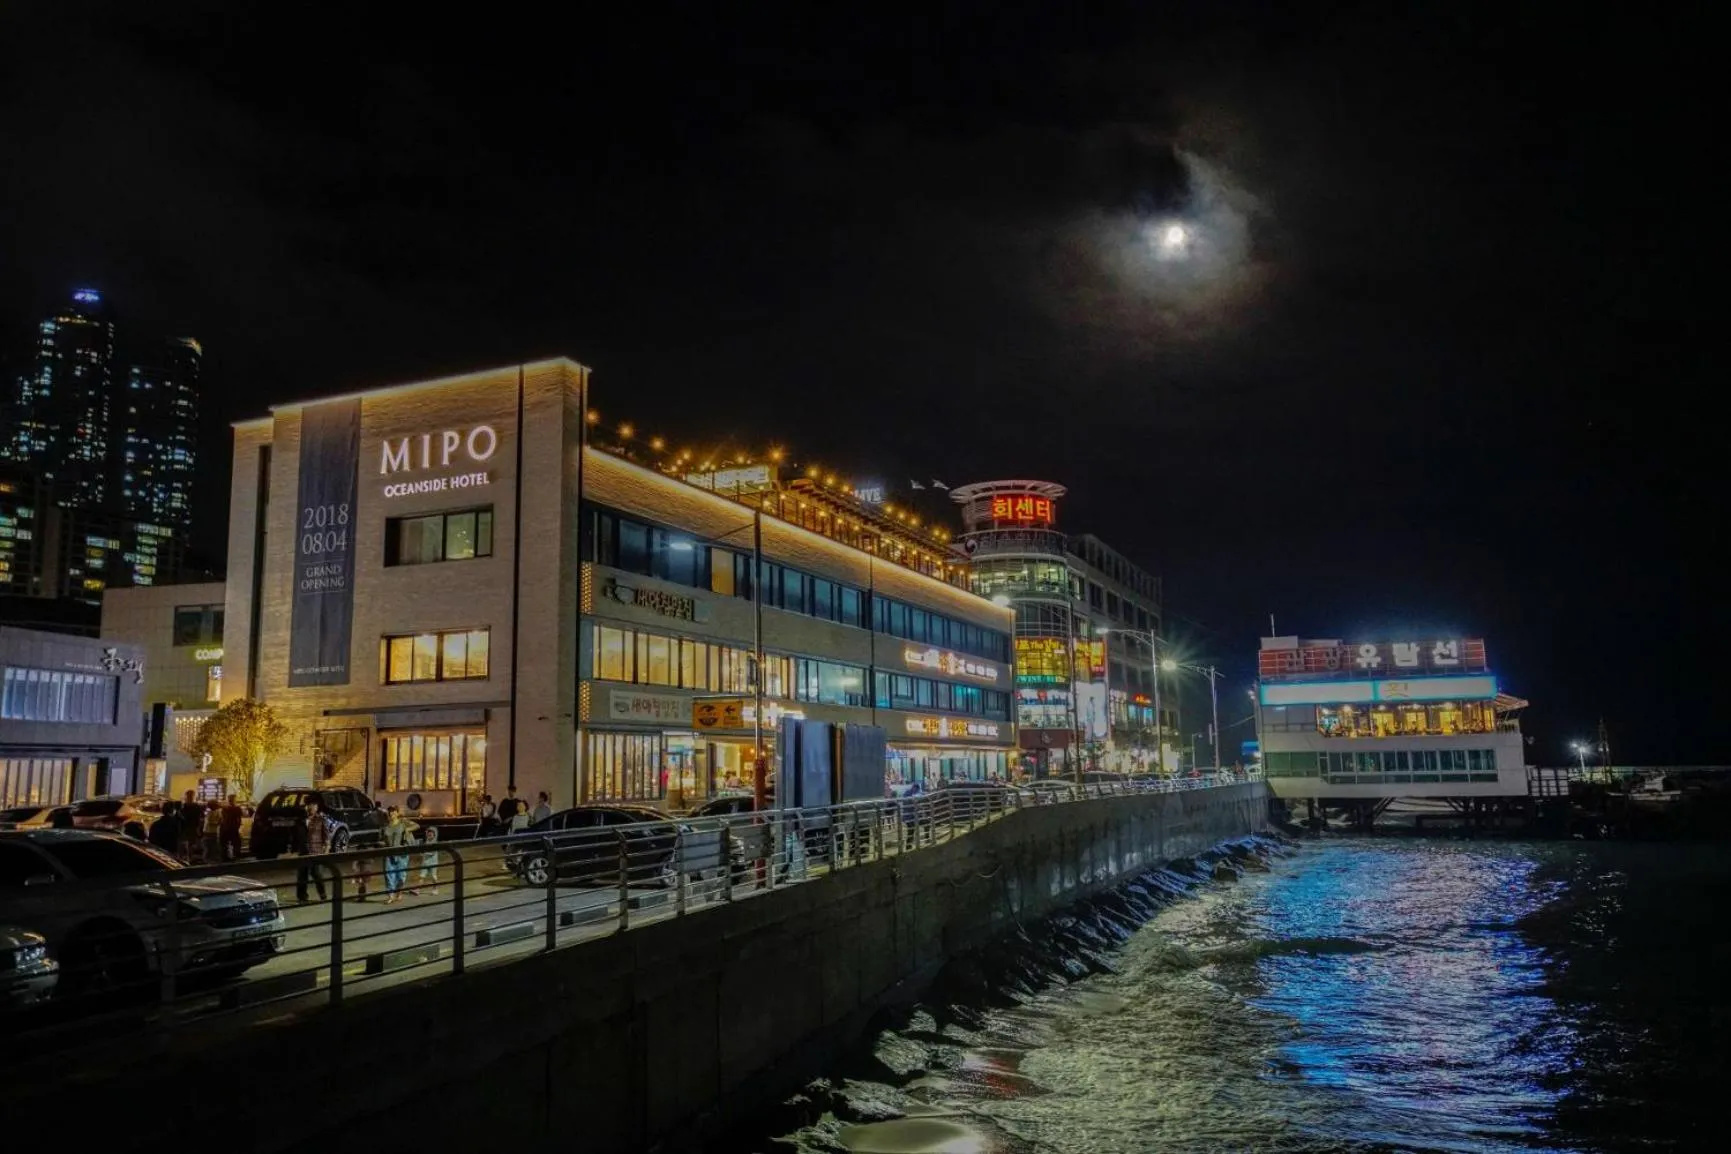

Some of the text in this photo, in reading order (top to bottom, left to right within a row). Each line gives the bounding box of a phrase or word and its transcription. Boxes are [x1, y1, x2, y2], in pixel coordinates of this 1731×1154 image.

[380, 425, 496, 474] MIPO
[384, 472, 490, 497] OCEANSIDE HOTEL
[304, 503, 349, 528] 2018
[993, 497, 1051, 524] 회센터
[302, 529, 347, 555] 08.04
[301, 576, 345, 590] OPENING
[306, 563, 342, 578] GRAND
